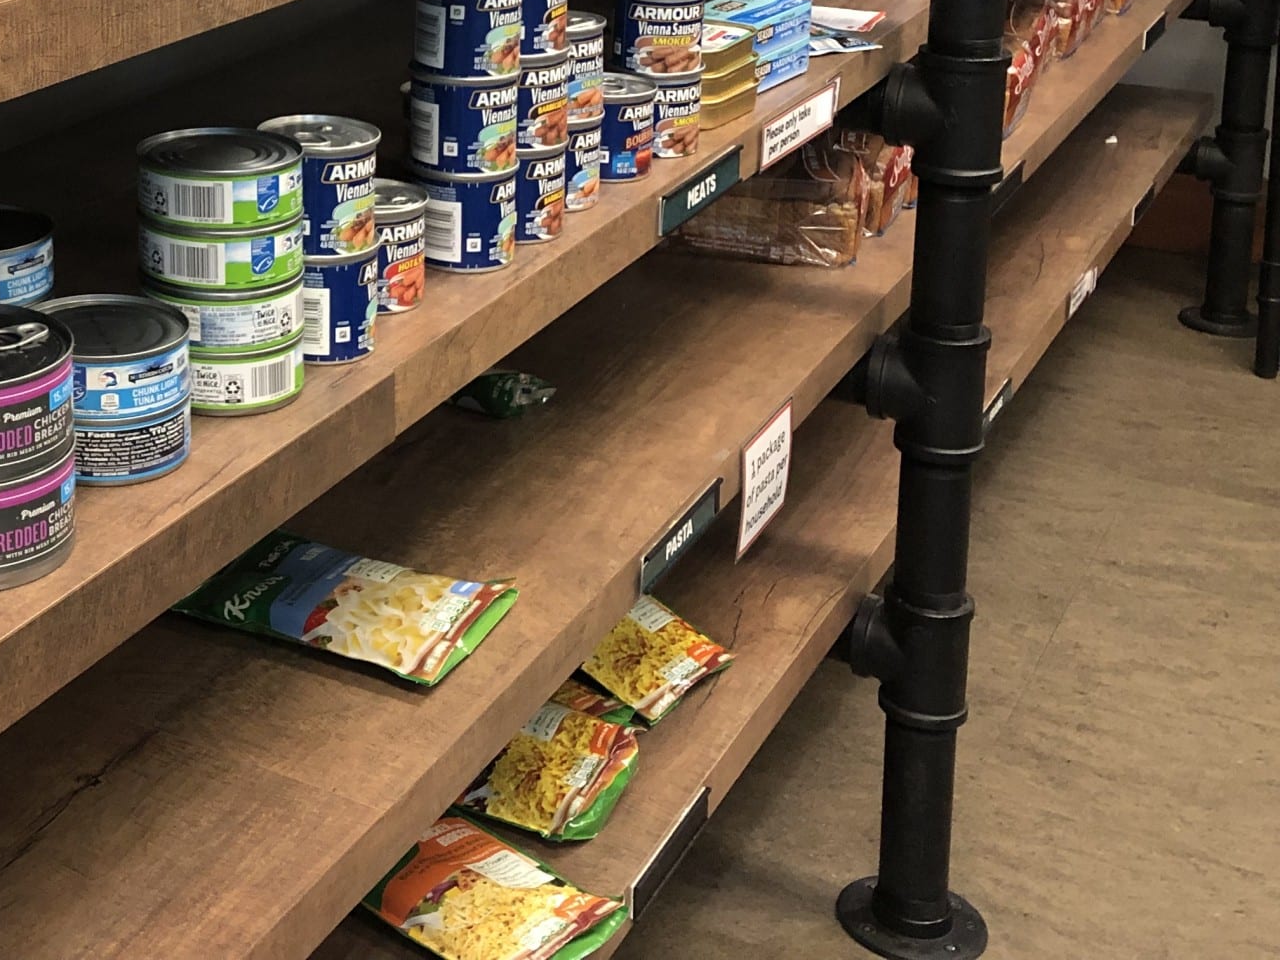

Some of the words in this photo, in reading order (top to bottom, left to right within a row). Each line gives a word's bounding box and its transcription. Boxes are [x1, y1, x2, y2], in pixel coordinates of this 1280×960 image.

[634, 5, 700, 20] ARMOUR
[638, 21, 672, 36] Vienna
[652, 35, 691, 46] SMOKED
[659, 105, 689, 120] Vienna
[765, 122, 785, 142] Please
[785, 115, 798, 133] only
[798, 105, 811, 122] take
[768, 141, 779, 156] per
[779, 130, 800, 150] person
[336, 183, 369, 203] Vienna
[687, 173, 717, 210] MEATS
[386, 243, 418, 263] Vienna
[131, 383, 160, 397] CHUNK
[160, 376, 178, 390] LIGHT
[133, 395, 155, 407] TUNA
[2, 404, 43, 424] Premium
[34, 416, 67, 442] BREAST
[756, 431, 786, 474] package
[746, 487, 755, 509] of
[755, 468, 775, 502] pasta
[776, 453, 788, 479] per
[20, 500, 56, 521] Premium
[745, 480, 783, 535] household
[666, 518, 694, 561] PASTA
[5, 551, 23, 559] WITH
